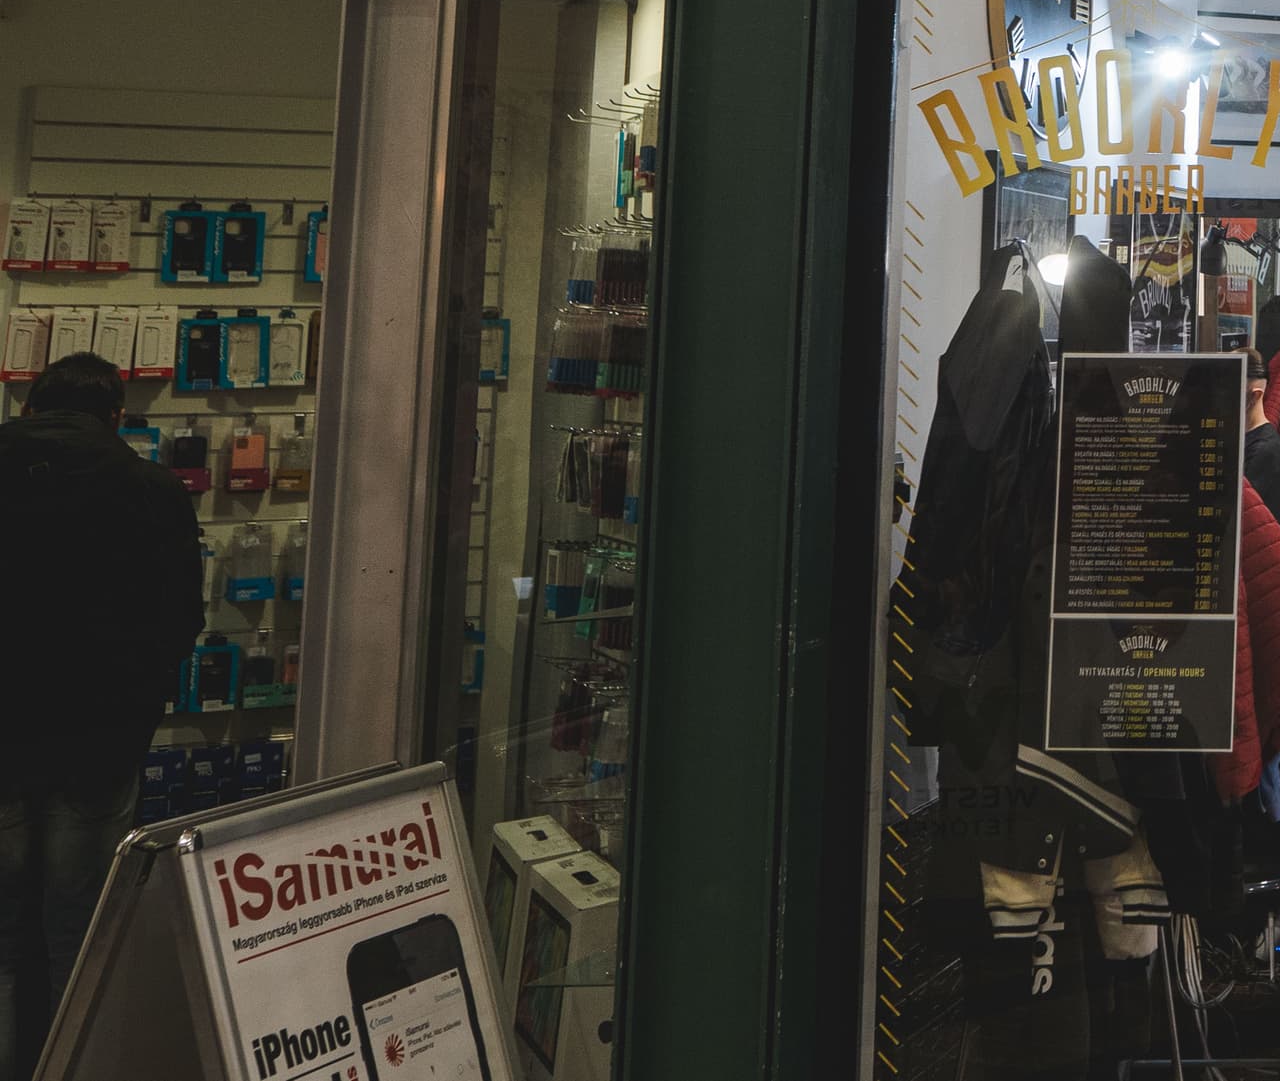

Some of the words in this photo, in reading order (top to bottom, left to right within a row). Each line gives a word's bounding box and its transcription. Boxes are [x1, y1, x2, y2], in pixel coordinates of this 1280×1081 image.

[1070, 164, 1205, 216] BARBER
[1124, 377, 1181, 397] BROOKLYN
[1119, 635, 1168, 653] BROOKLYN
[1079, 665, 1136, 677] NYITVATARTÁS
[1143, 667, 1177, 677] OPENING
[1179, 668, 1206, 677] HOURS
[214, 802, 442, 928] iSamurai
[232, 922, 297, 952] Magyarország
[299, 903, 352, 933] leggyorsabb
[353, 893, 384, 911] iPhone
[385, 888, 395, 901] és
[395, 884, 415, 898] iPad
[415, 872, 448, 891] szervize
[252, 1013, 352, 1081] iPhone
